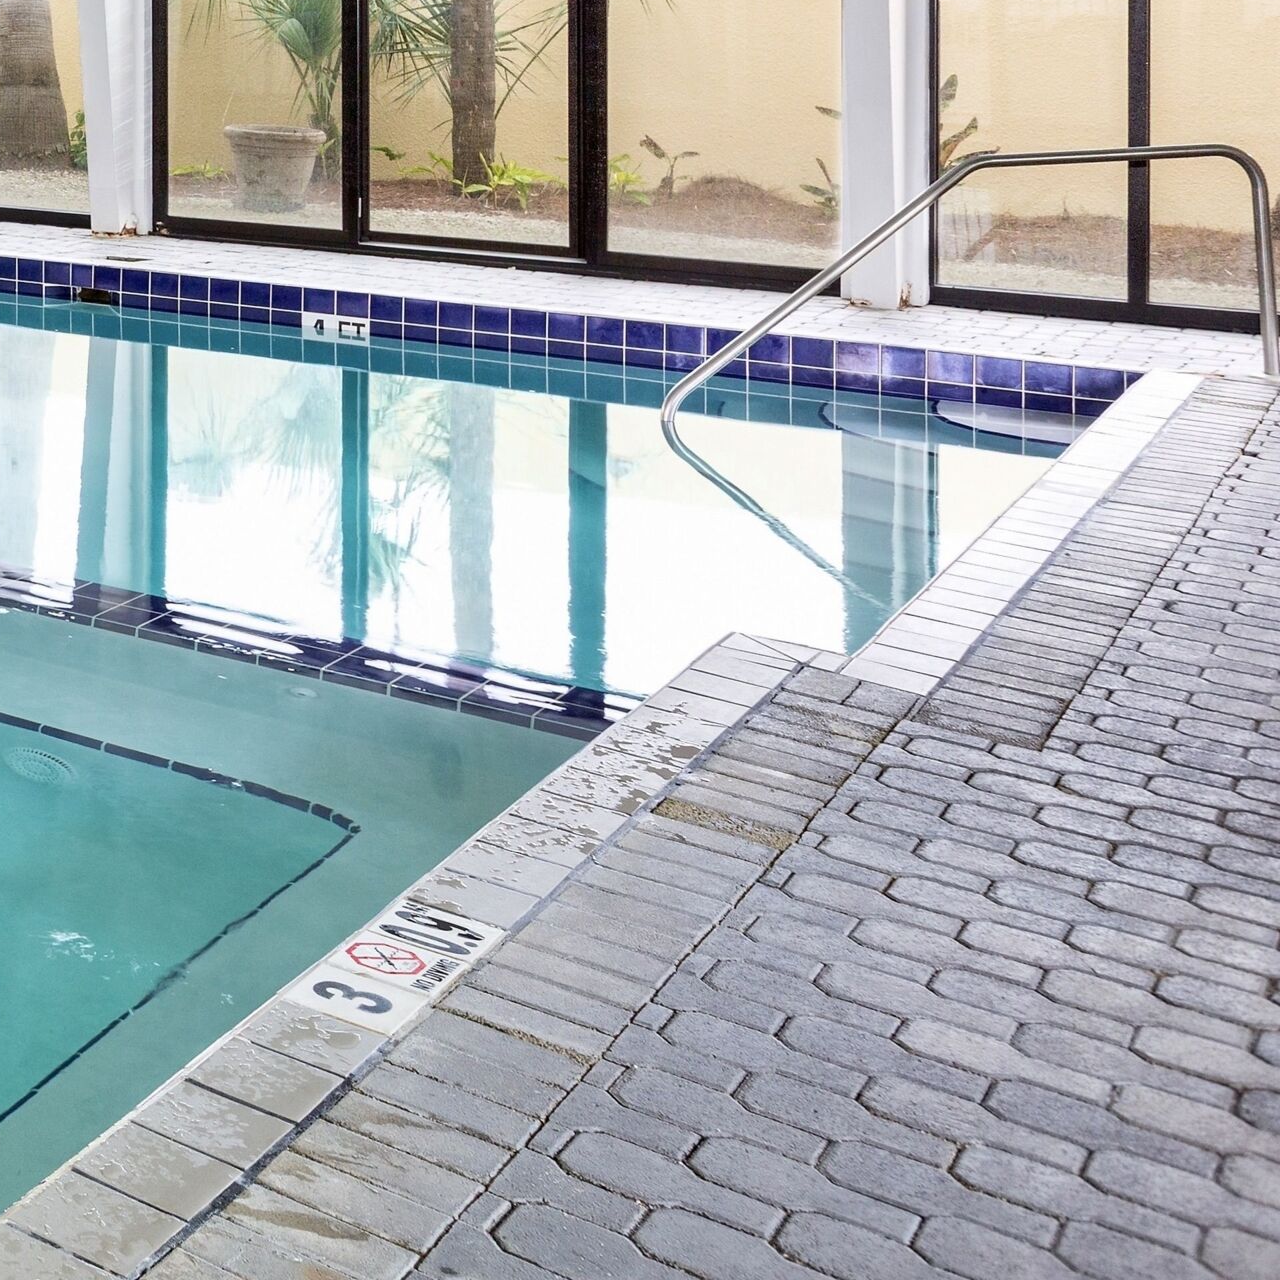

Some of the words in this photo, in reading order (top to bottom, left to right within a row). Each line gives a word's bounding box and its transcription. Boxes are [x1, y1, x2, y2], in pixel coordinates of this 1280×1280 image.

[422, 959, 460, 982] DIVING
[410, 979, 436, 992] NO
[313, 981, 393, 1014] 3
